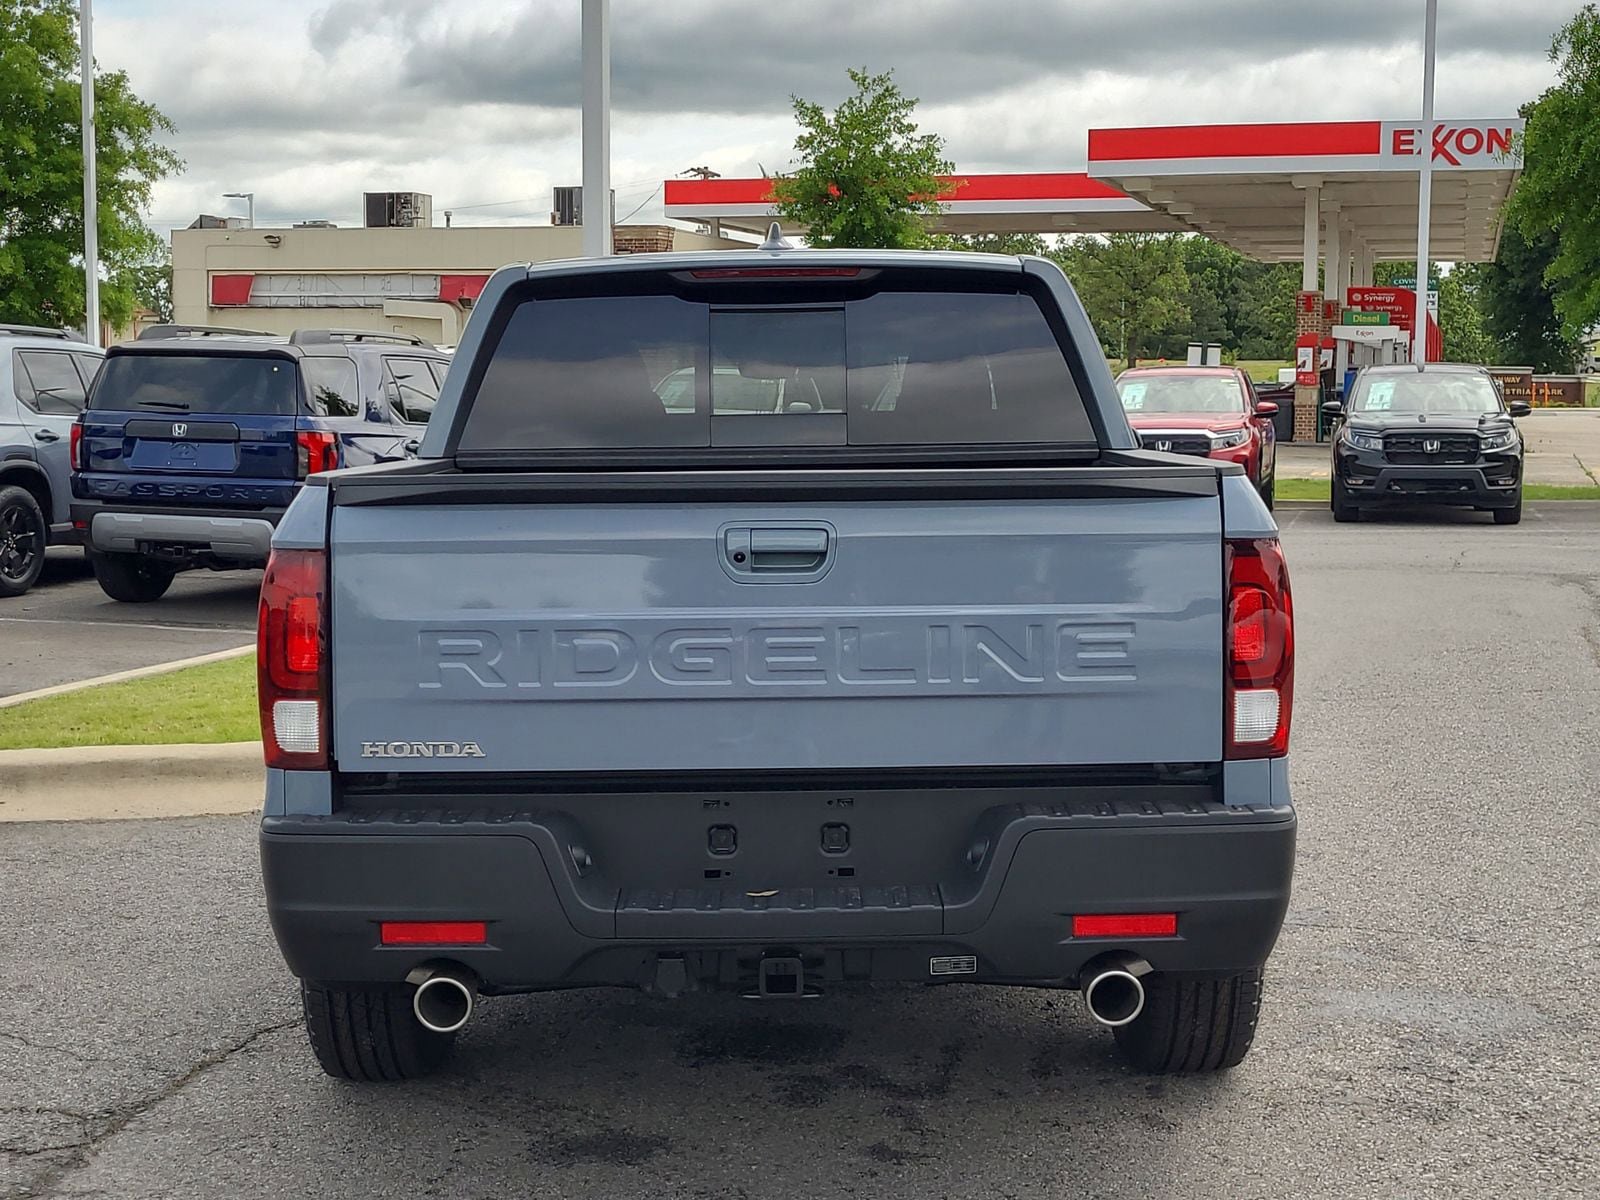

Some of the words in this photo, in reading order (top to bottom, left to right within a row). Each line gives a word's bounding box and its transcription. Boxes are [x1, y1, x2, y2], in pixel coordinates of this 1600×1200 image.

[1363, 294, 1396, 303] Synergy
[1352, 314, 1380, 323] Diesel
[94, 479, 277, 500] PASSPORT
[418, 621, 1137, 689] RIDGELINE
[361, 741, 486, 758] HONDA
